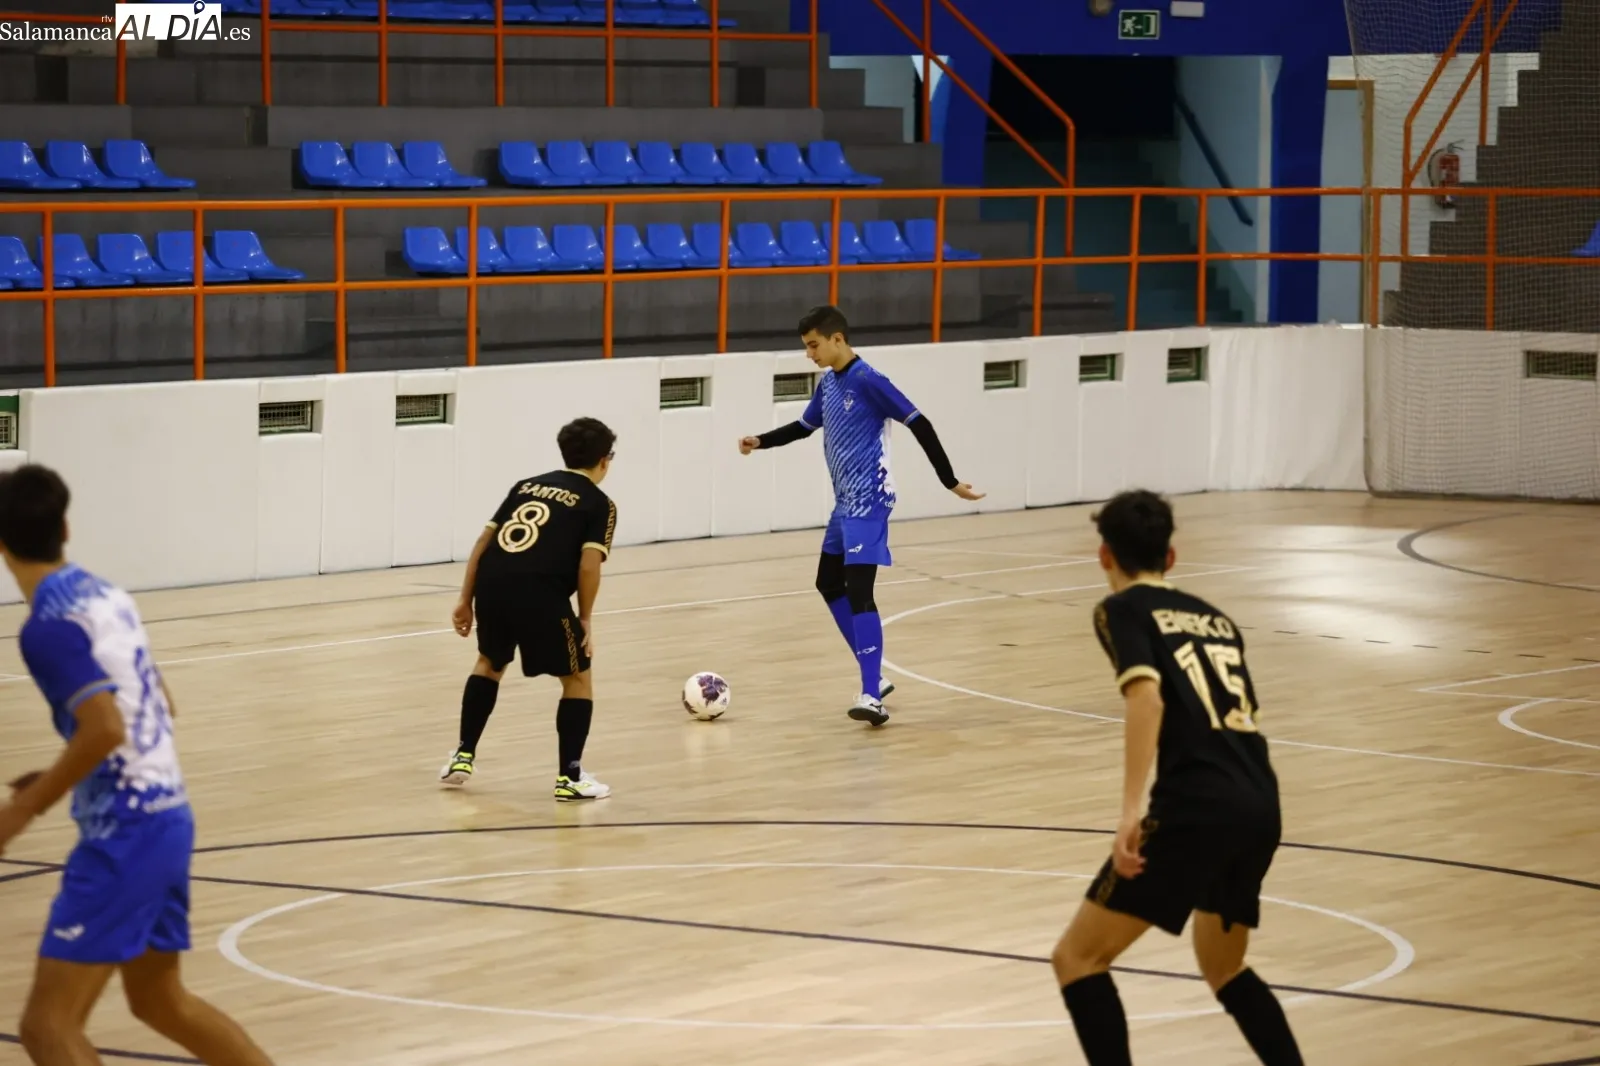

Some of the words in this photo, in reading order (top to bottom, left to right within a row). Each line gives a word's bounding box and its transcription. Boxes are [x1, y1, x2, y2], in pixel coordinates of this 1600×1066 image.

[518, 482, 580, 507] SANTOS
[497, 500, 550, 553] 8
[1173, 640, 1258, 732] 15
